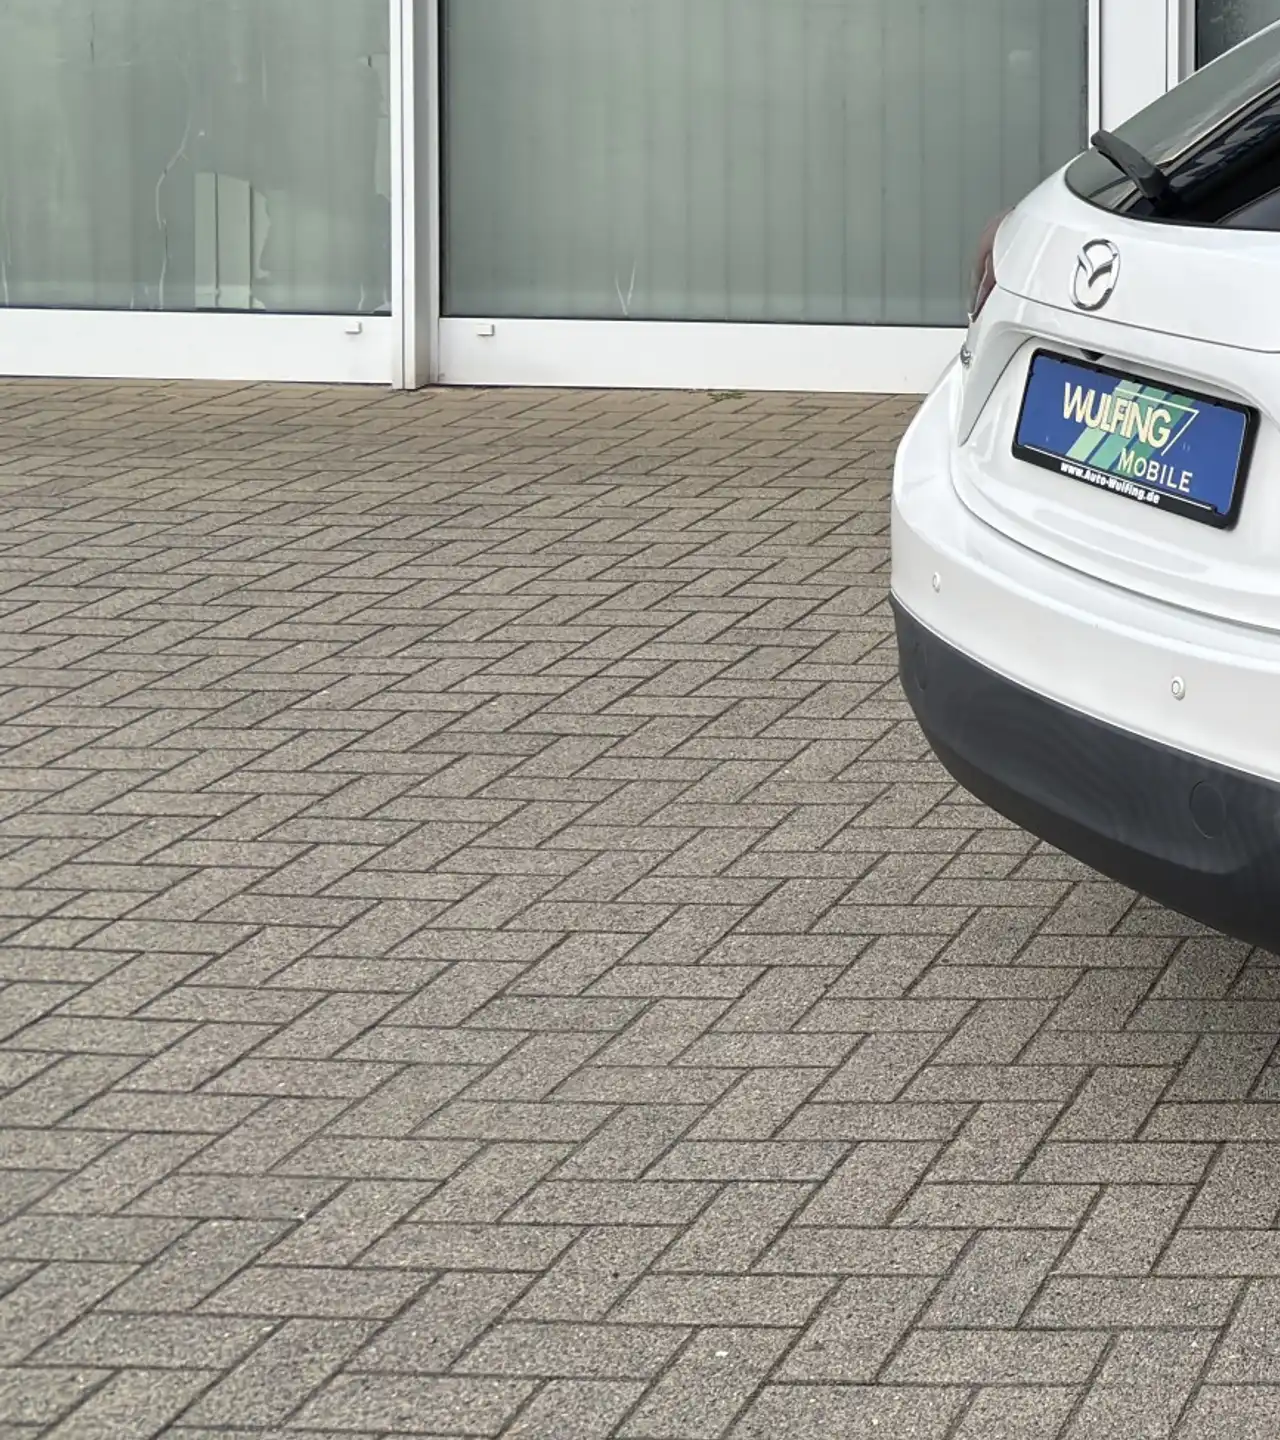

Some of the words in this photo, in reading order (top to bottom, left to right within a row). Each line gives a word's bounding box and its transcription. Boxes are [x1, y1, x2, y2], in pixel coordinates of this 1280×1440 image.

[1062, 381, 1171, 448] WULFING
[1060, 461, 1160, 504] www.Auto-Wulfing.de
[1117, 447, 1193, 493] MOBILE
